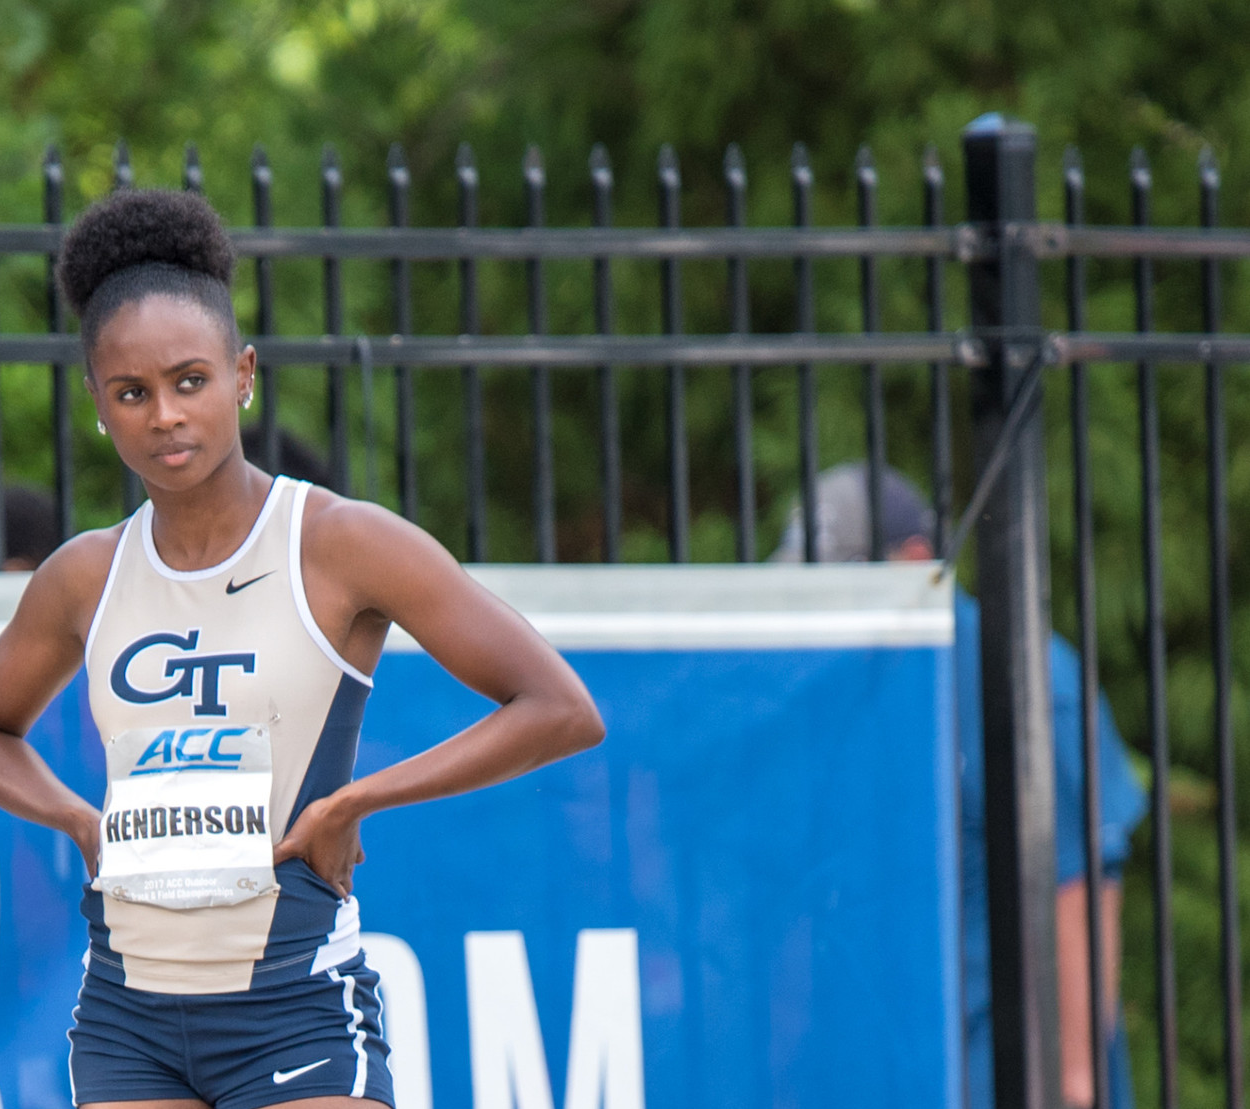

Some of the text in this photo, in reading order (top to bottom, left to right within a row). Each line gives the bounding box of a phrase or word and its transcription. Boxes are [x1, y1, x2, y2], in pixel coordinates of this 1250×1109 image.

[110, 629, 256, 717] GT
[135, 727, 251, 768] ACC
[106, 805, 267, 843] HENDERSON
[144, 879, 165, 890] 2017
[166, 878, 183, 889] ACC
